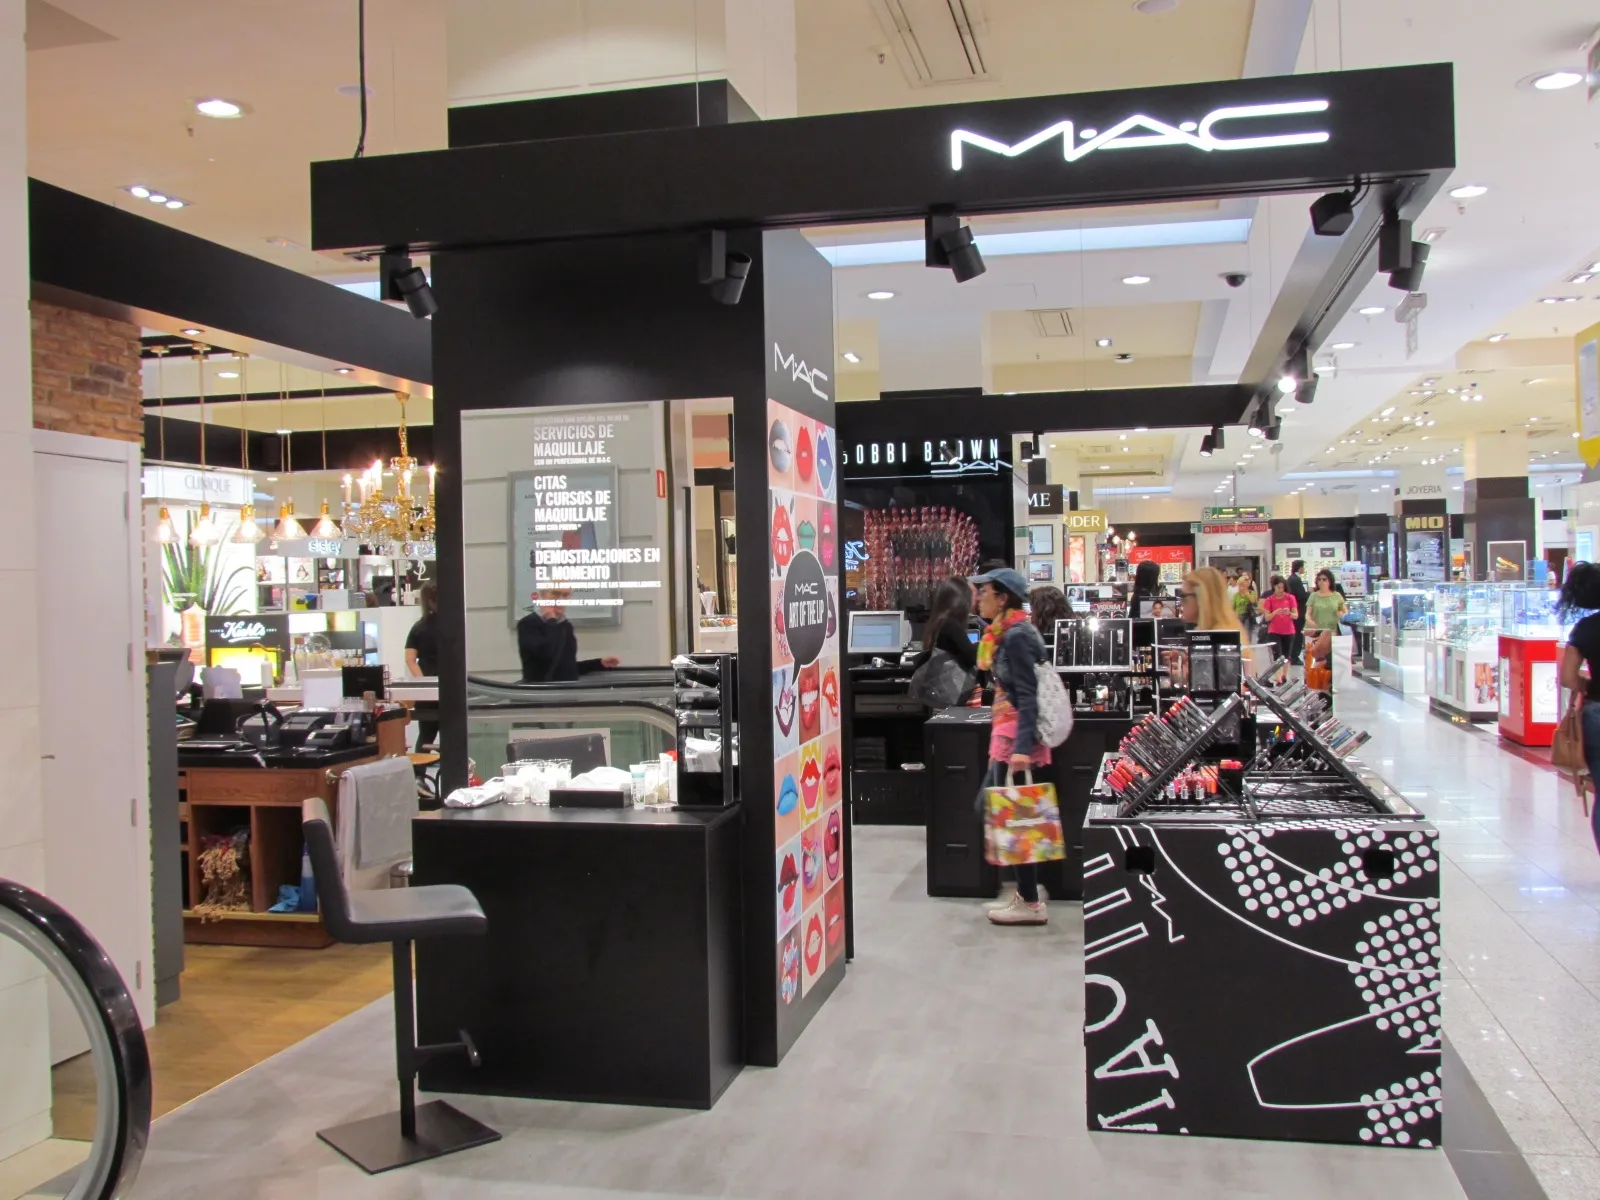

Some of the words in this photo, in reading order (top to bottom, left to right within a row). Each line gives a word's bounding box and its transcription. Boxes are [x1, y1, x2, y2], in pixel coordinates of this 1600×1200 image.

[533, 424, 596, 441] SERVICIOS
[599, 423, 615, 438] DE
[533, 440, 606, 457] MAQUILLAJE
[184, 474, 233, 496] CLINIQUE
[533, 475, 567, 490] CITAS
[535, 491, 544, 506] Y
[545, 490, 593, 506] CURSOS
[595, 490, 612, 505] DE
[534, 506, 607, 523] MAQUILLAJE
[1405, 516, 1445, 530] MIO
[308, 538, 342, 556] sisley
[535, 549, 642, 565] DEMOSTRACIONES
[644, 547, 661, 563] EN
[535, 565, 550, 581] EL
[551, 565, 611, 581] MOMENTO
[788, 602, 799, 629] ART
[799, 600, 807, 628] OF
[807, 599, 816, 626] THE
[816, 599, 825, 624] LIP
[220, 620, 266, 643] Kiehl's
